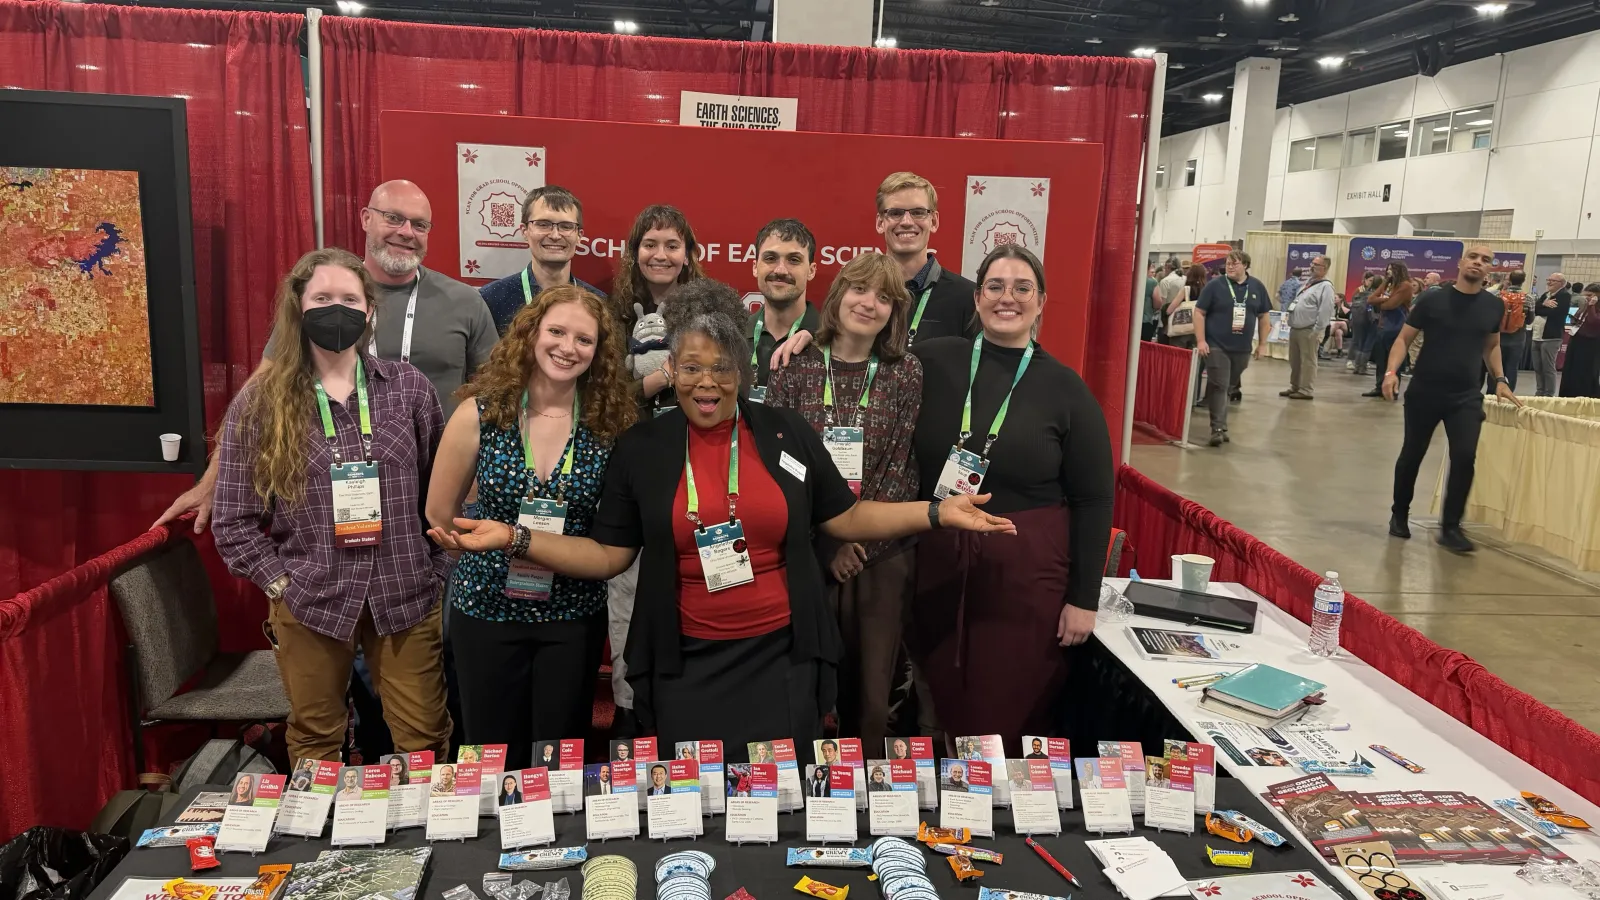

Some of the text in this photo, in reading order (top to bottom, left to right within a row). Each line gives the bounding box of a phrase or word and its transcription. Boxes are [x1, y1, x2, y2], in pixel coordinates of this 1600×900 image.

[696, 102, 729, 121] EARTH
[731, 105, 781, 126] SCIENCES,
[1347, 191, 1367, 200] EXHIBIT
[1367, 190, 1381, 199] HALL
[982, 212, 994, 222] GRAD
[1295, 775, 1323, 786] ORTON
[1277, 779, 1326, 794] GEOLOGICAL
[1295, 783, 1329, 794] MUSEUM
